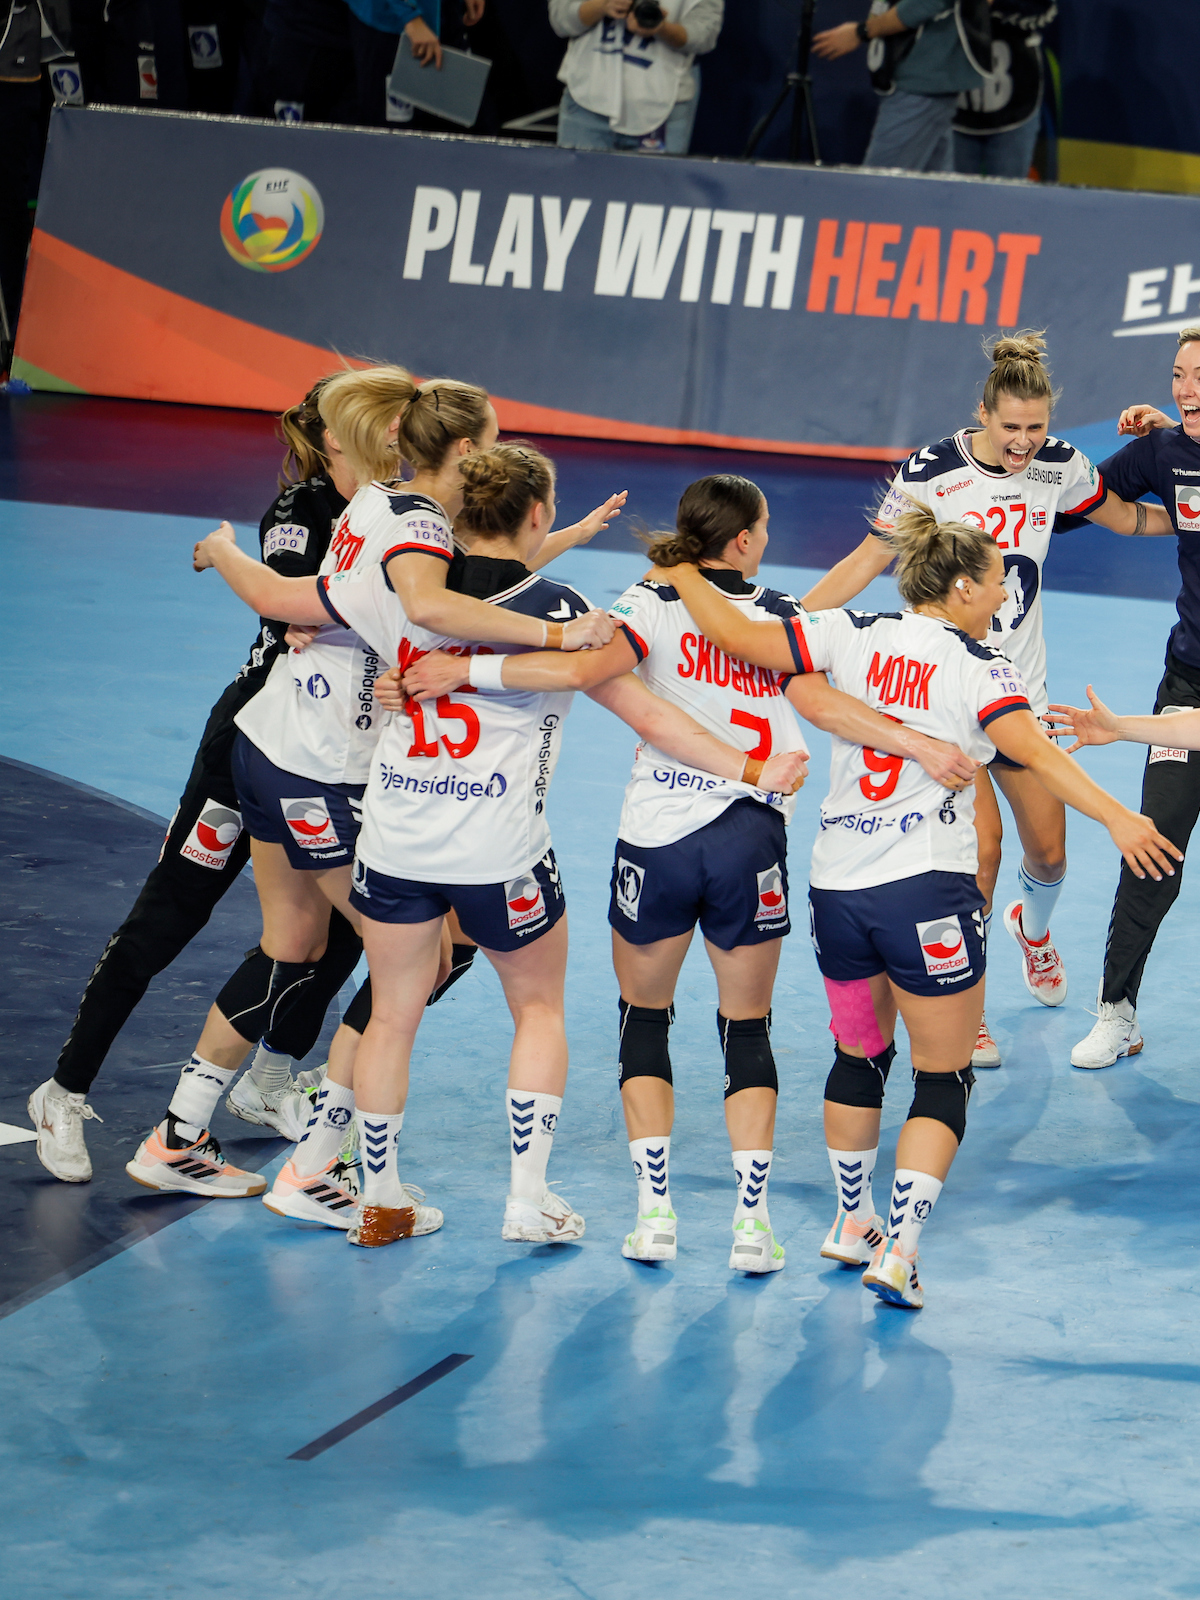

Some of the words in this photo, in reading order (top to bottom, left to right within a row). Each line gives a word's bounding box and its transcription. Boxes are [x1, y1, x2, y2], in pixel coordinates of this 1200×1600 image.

[266, 179, 290, 192] EHF
[403, 186, 592, 291] PLAY
[594, 201, 804, 310] WITH
[806, 219, 1042, 327] HEART
[945, 478, 974, 496] posten
[998, 493, 1022, 501] hummel
[985, 503, 1027, 549] 27
[414, 530, 449, 549] 1000
[406, 694, 480, 760] 15
[730, 708, 772, 762] 7
[859, 713, 905, 801] 9
[1150, 748, 1186, 763] posten
[296, 835, 338, 847] posten
[182, 844, 225, 867] posten
[318, 848, 349, 860] hummel
[510, 906, 544, 927] posten
[928, 956, 968, 973] posten
[946, 969, 974, 984] hummel
